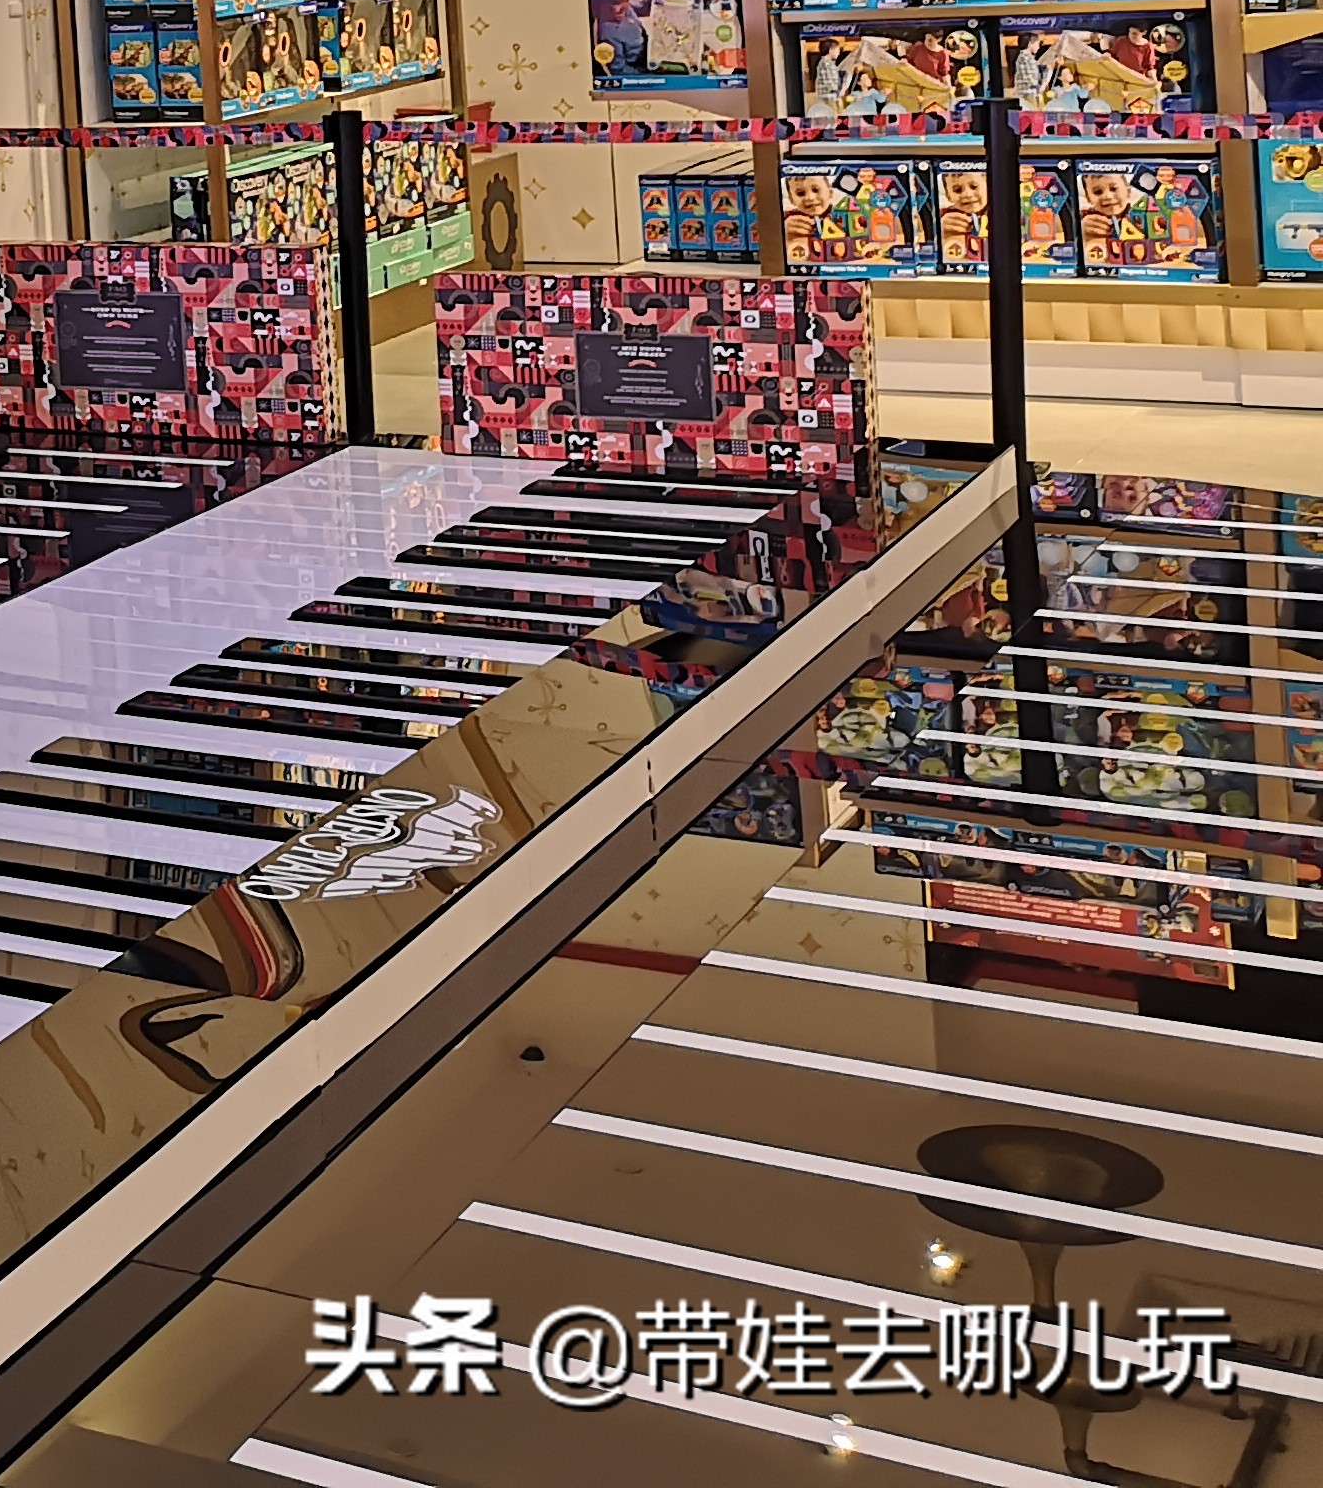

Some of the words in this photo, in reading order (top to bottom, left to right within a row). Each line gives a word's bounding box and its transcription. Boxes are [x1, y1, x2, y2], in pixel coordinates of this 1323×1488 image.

[802, 23, 857, 35] Discovery
[782, 165, 837, 175] Discovery
[1078, 159, 1135, 172] Discovery
